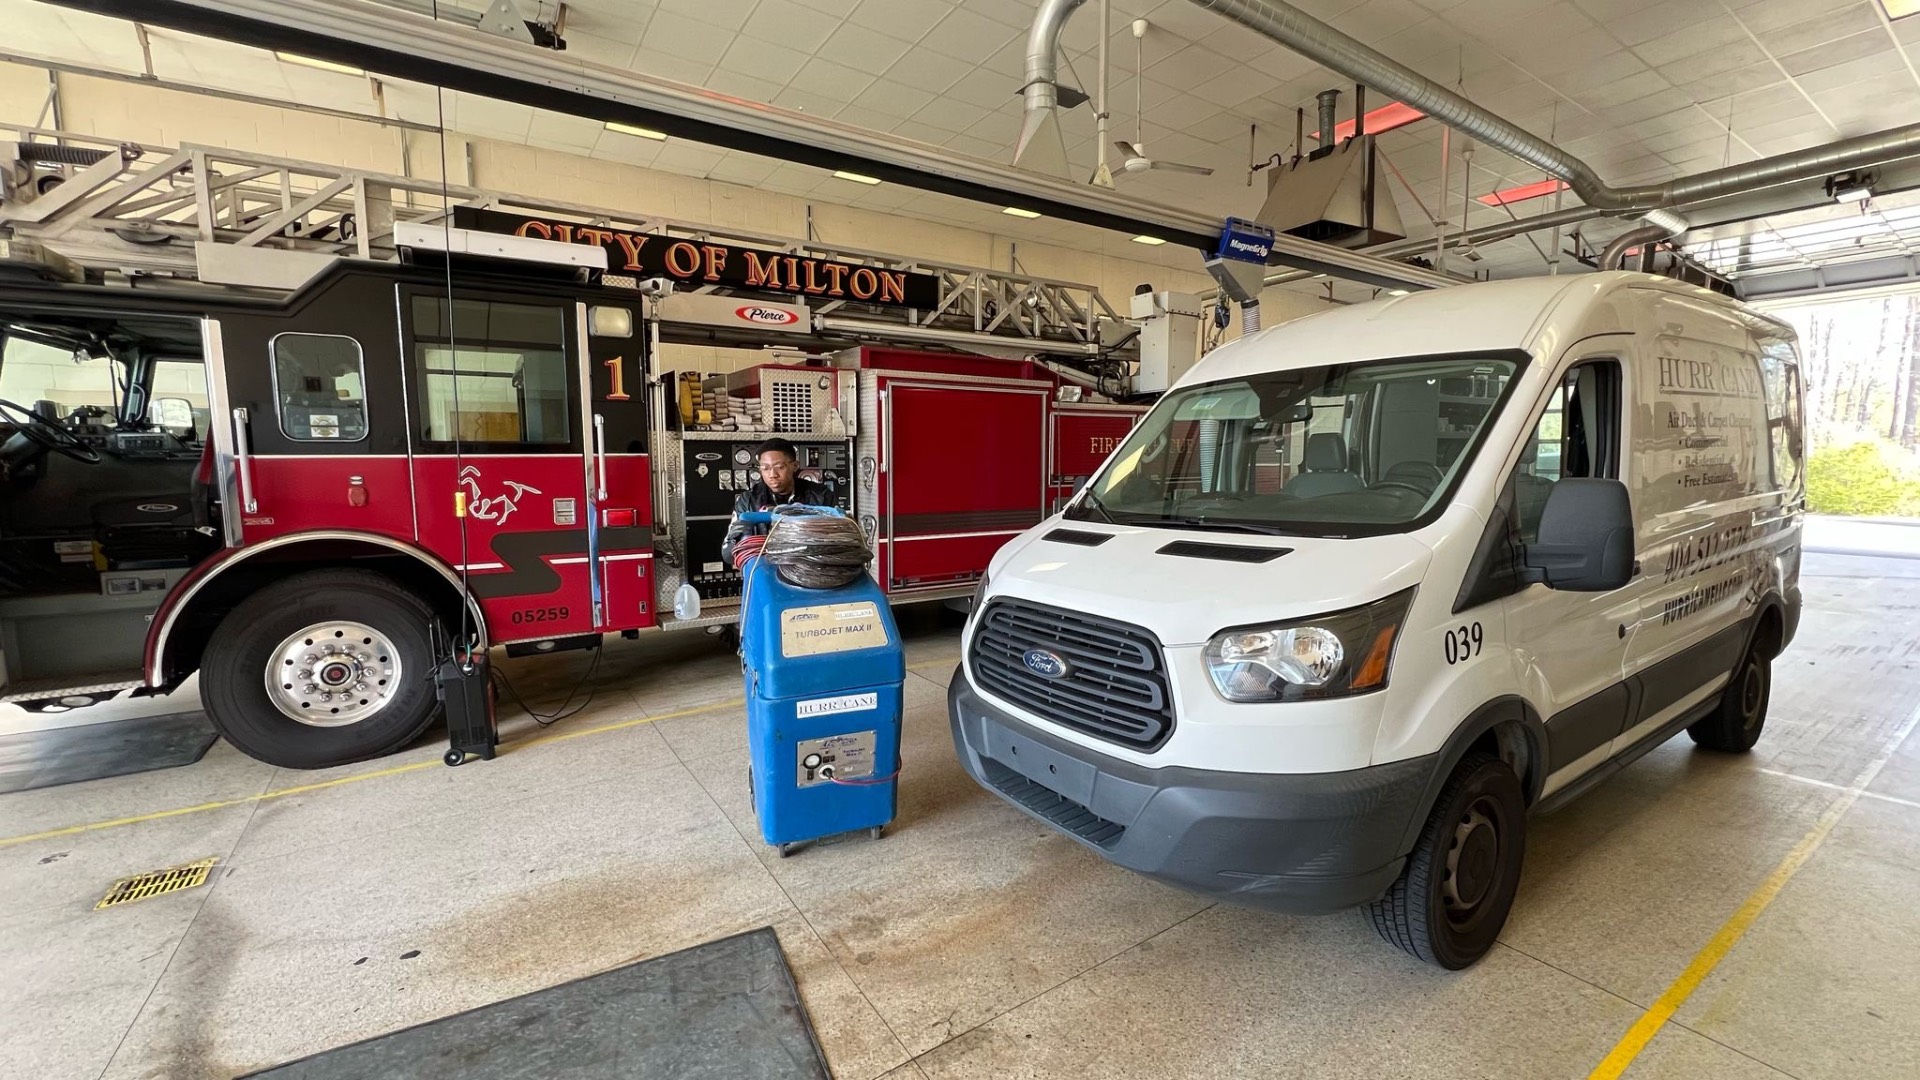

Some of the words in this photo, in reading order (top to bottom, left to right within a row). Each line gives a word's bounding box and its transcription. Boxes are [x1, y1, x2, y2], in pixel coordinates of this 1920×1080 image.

[665, 242, 728, 281] OF
[743, 252, 906, 303] MILTON
[750, 308, 786, 321] Pierce
[604, 356, 630, 400] 1
[1667, 411, 1680, 428] Air
[1684, 474, 1701, 488] Free
[512, 607, 569, 624] 05259
[795, 626, 843, 639] TURBOJET
[845, 625, 865, 633] MAX
[1444, 621, 1483, 665] 039
[1028, 653, 1053, 673] Ford
